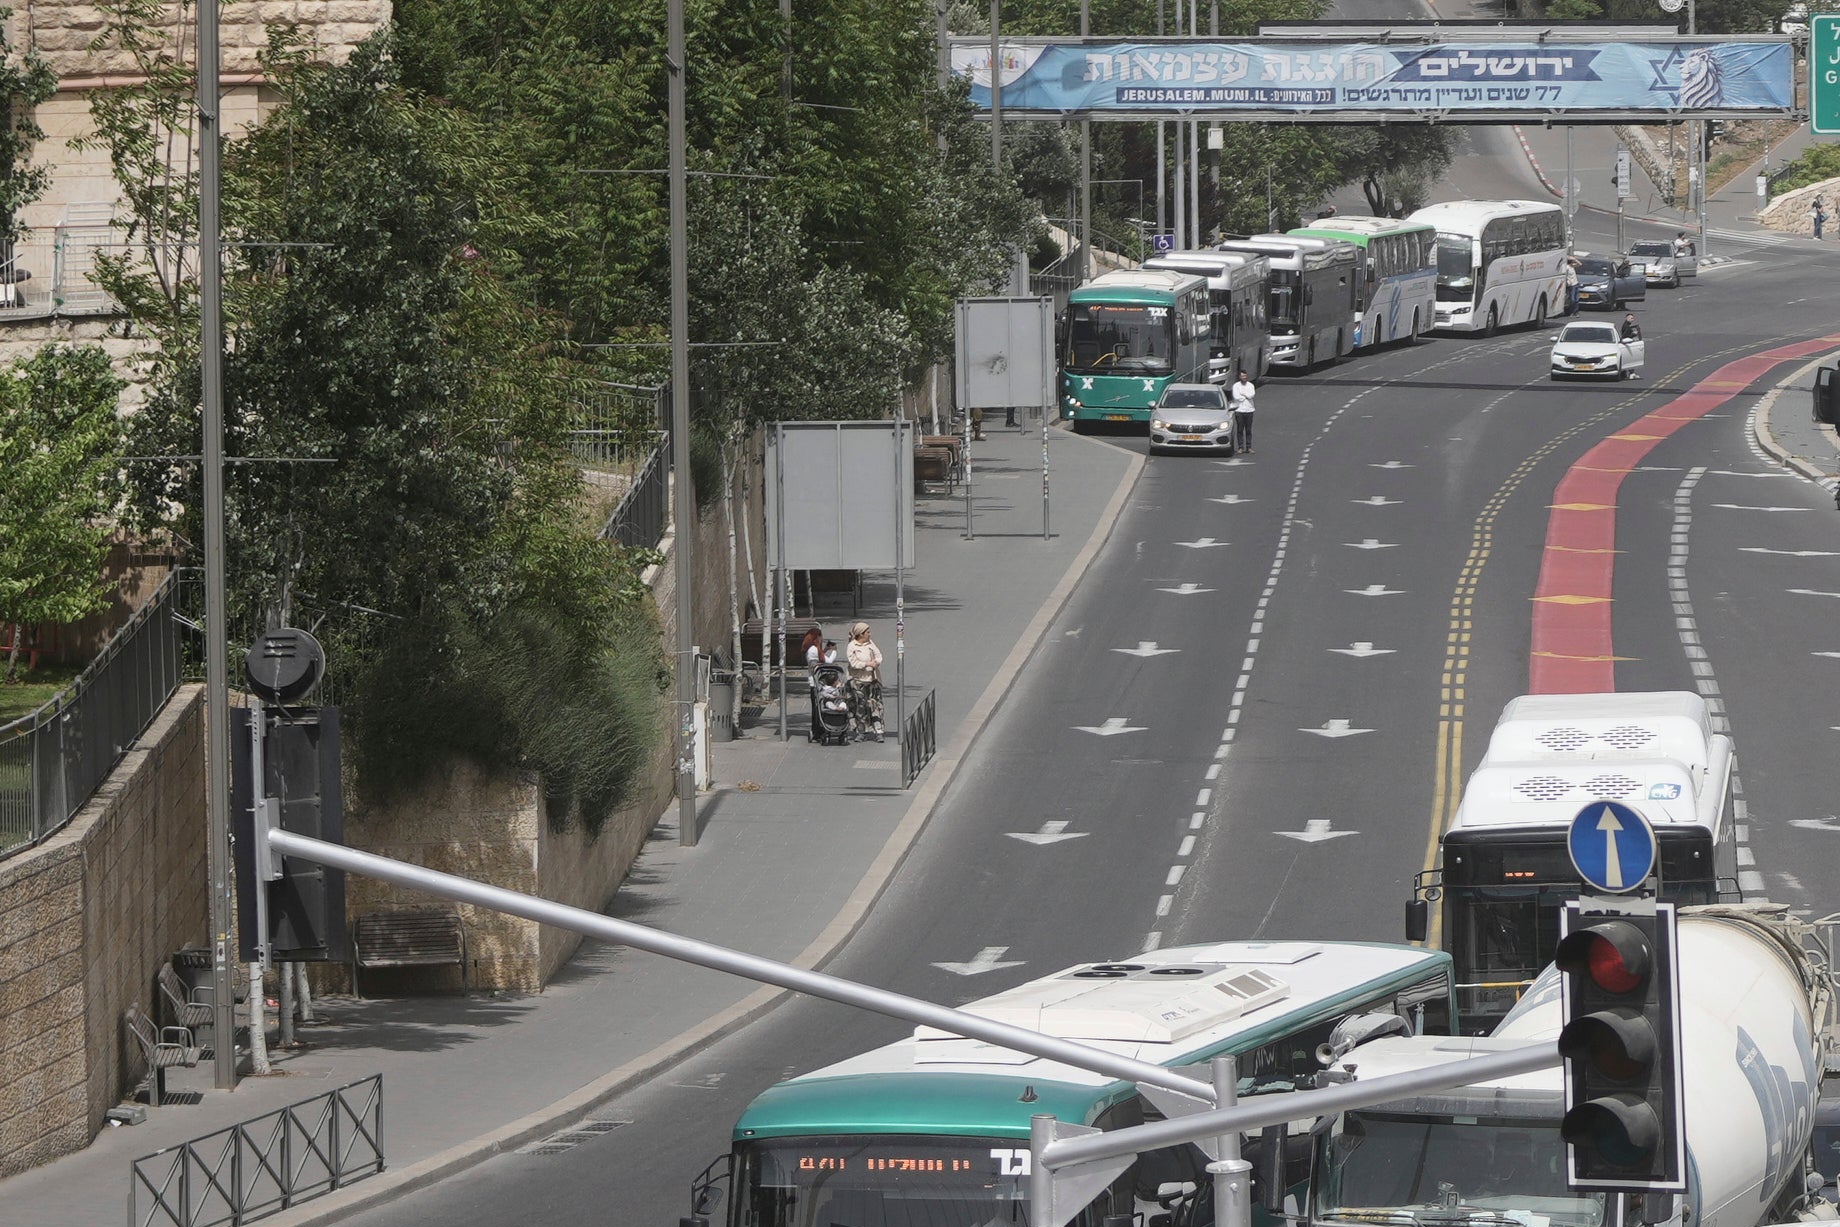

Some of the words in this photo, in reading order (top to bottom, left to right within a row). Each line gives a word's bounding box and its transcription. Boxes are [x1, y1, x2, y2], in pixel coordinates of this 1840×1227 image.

[1083, 52, 1249, 84] עצמאות
[1260, 52, 1385, 83] חוגגת
[1418, 50, 1573, 77] ירושלים
[1121, 87, 1268, 103] JERUSALEM.MUNI.IL
[1269, 89, 1313, 104] האירועים:
[1314, 89, 1332, 103] לכל
[1343, 87, 1431, 103] מתרגשים!
[1436, 87, 1489, 107] ועדיין
[1491, 87, 1531, 102] שנים
[1536, 86, 1562, 101] 77
